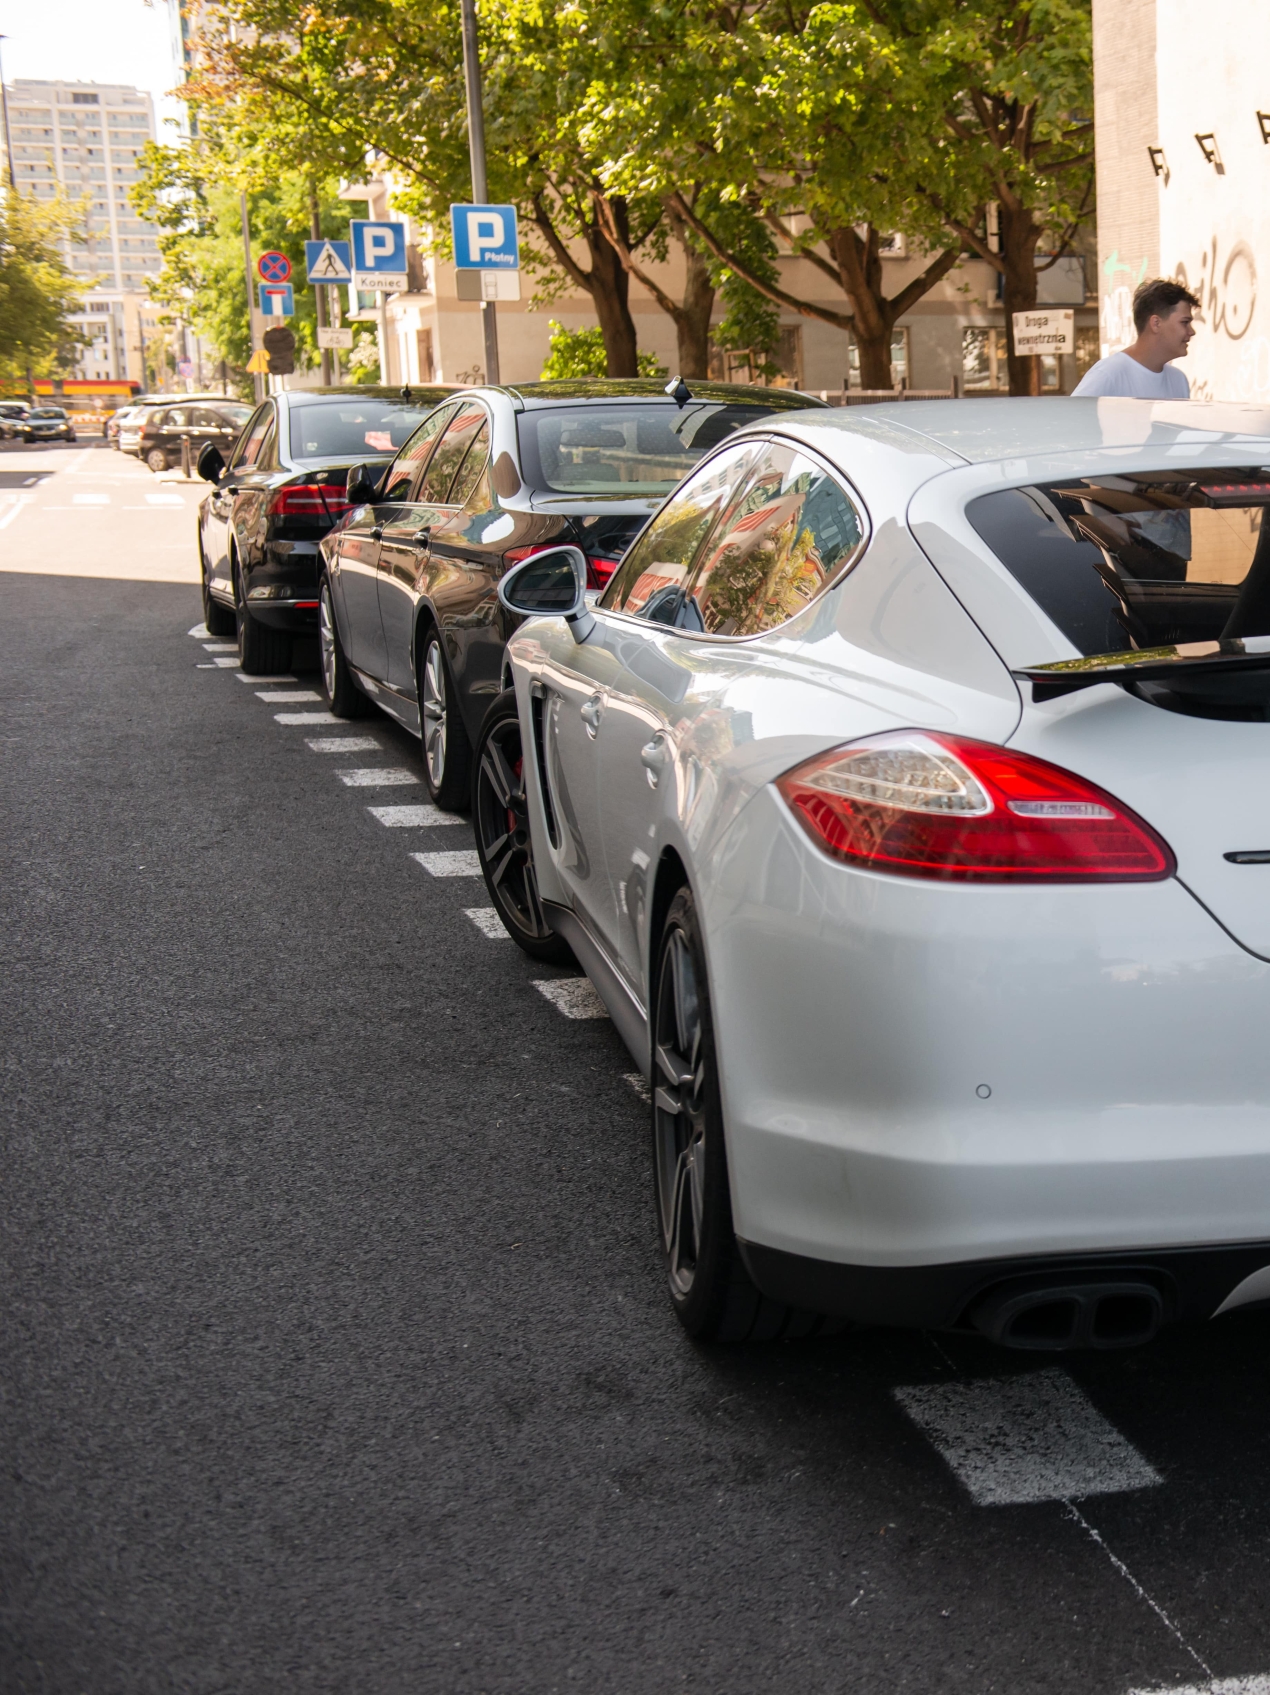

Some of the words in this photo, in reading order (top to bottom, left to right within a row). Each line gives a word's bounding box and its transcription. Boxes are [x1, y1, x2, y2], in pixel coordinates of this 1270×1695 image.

[363, 226, 395, 267] P
[466, 211, 505, 262] P
[360, 277, 402, 288] Koniec
